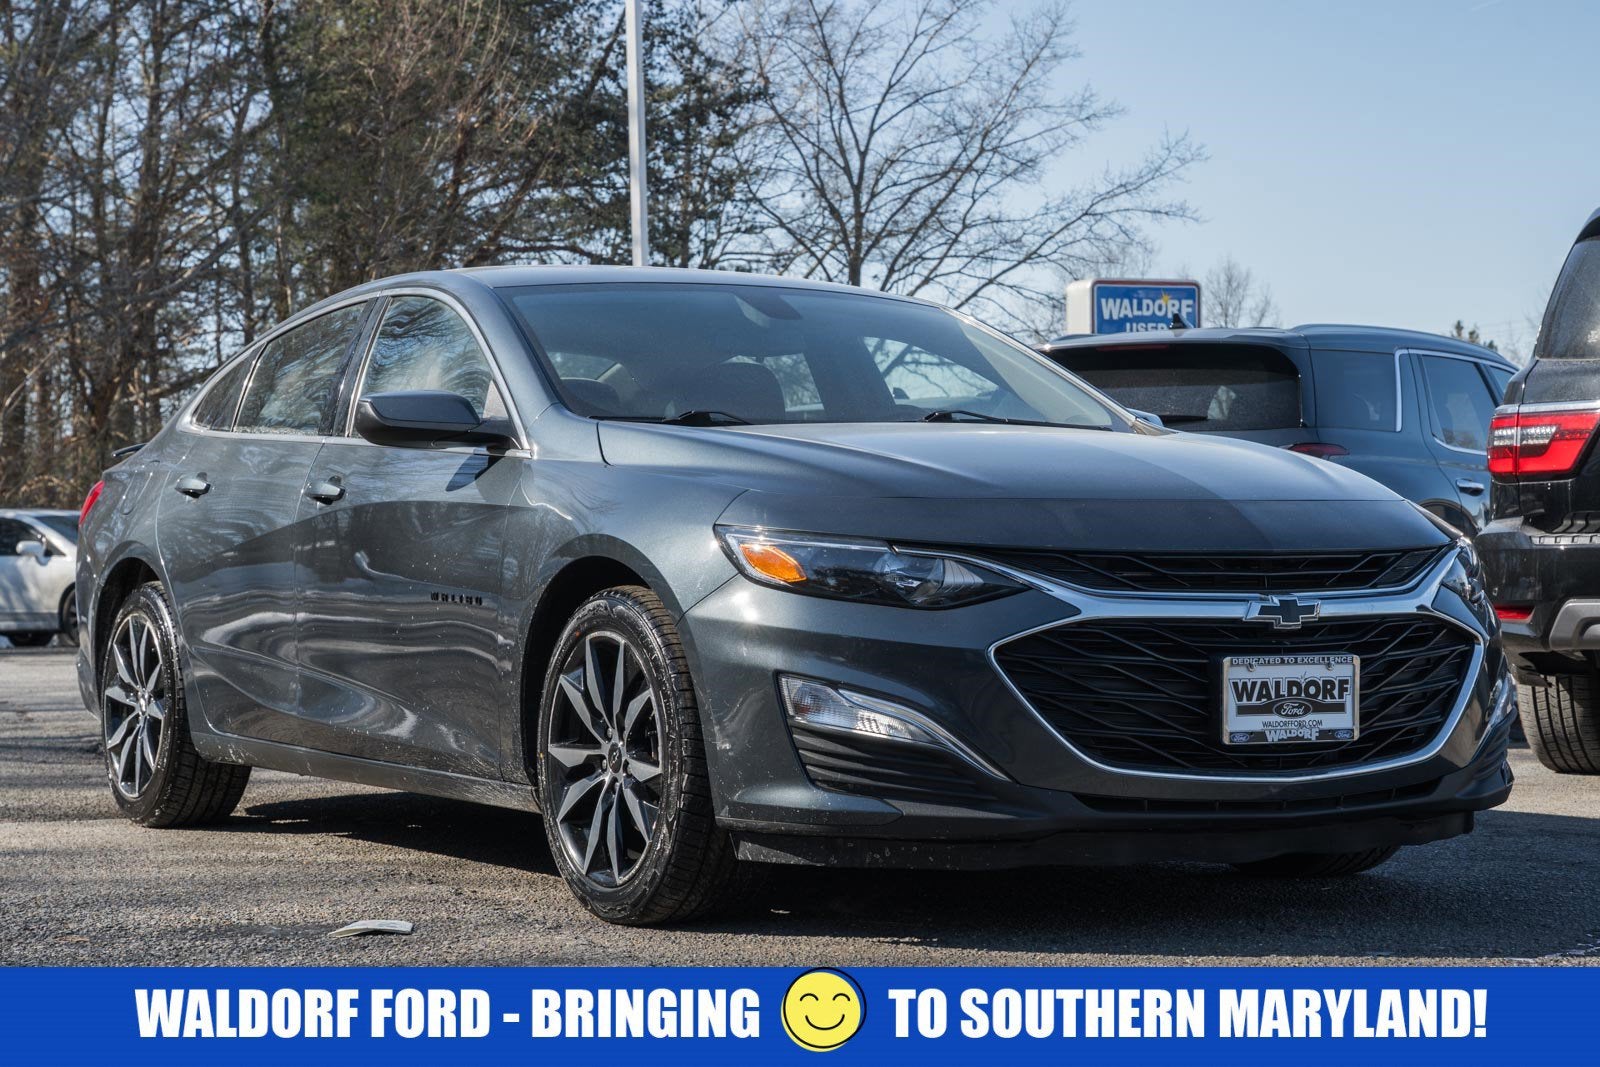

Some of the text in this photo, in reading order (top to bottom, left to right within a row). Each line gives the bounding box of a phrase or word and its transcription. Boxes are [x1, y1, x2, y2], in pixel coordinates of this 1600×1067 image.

[1101, 298, 1194, 320] WALDORF
[1232, 657, 1281, 665] DEDICATED
[1298, 656, 1353, 664] EXCELLENCE
[1230, 676, 1351, 702] WALDORF
[1281, 703, 1305, 716] Ford
[1262, 719, 1323, 729] WALDORFFORD.COM
[1264, 728, 1320, 742] WALDORF
